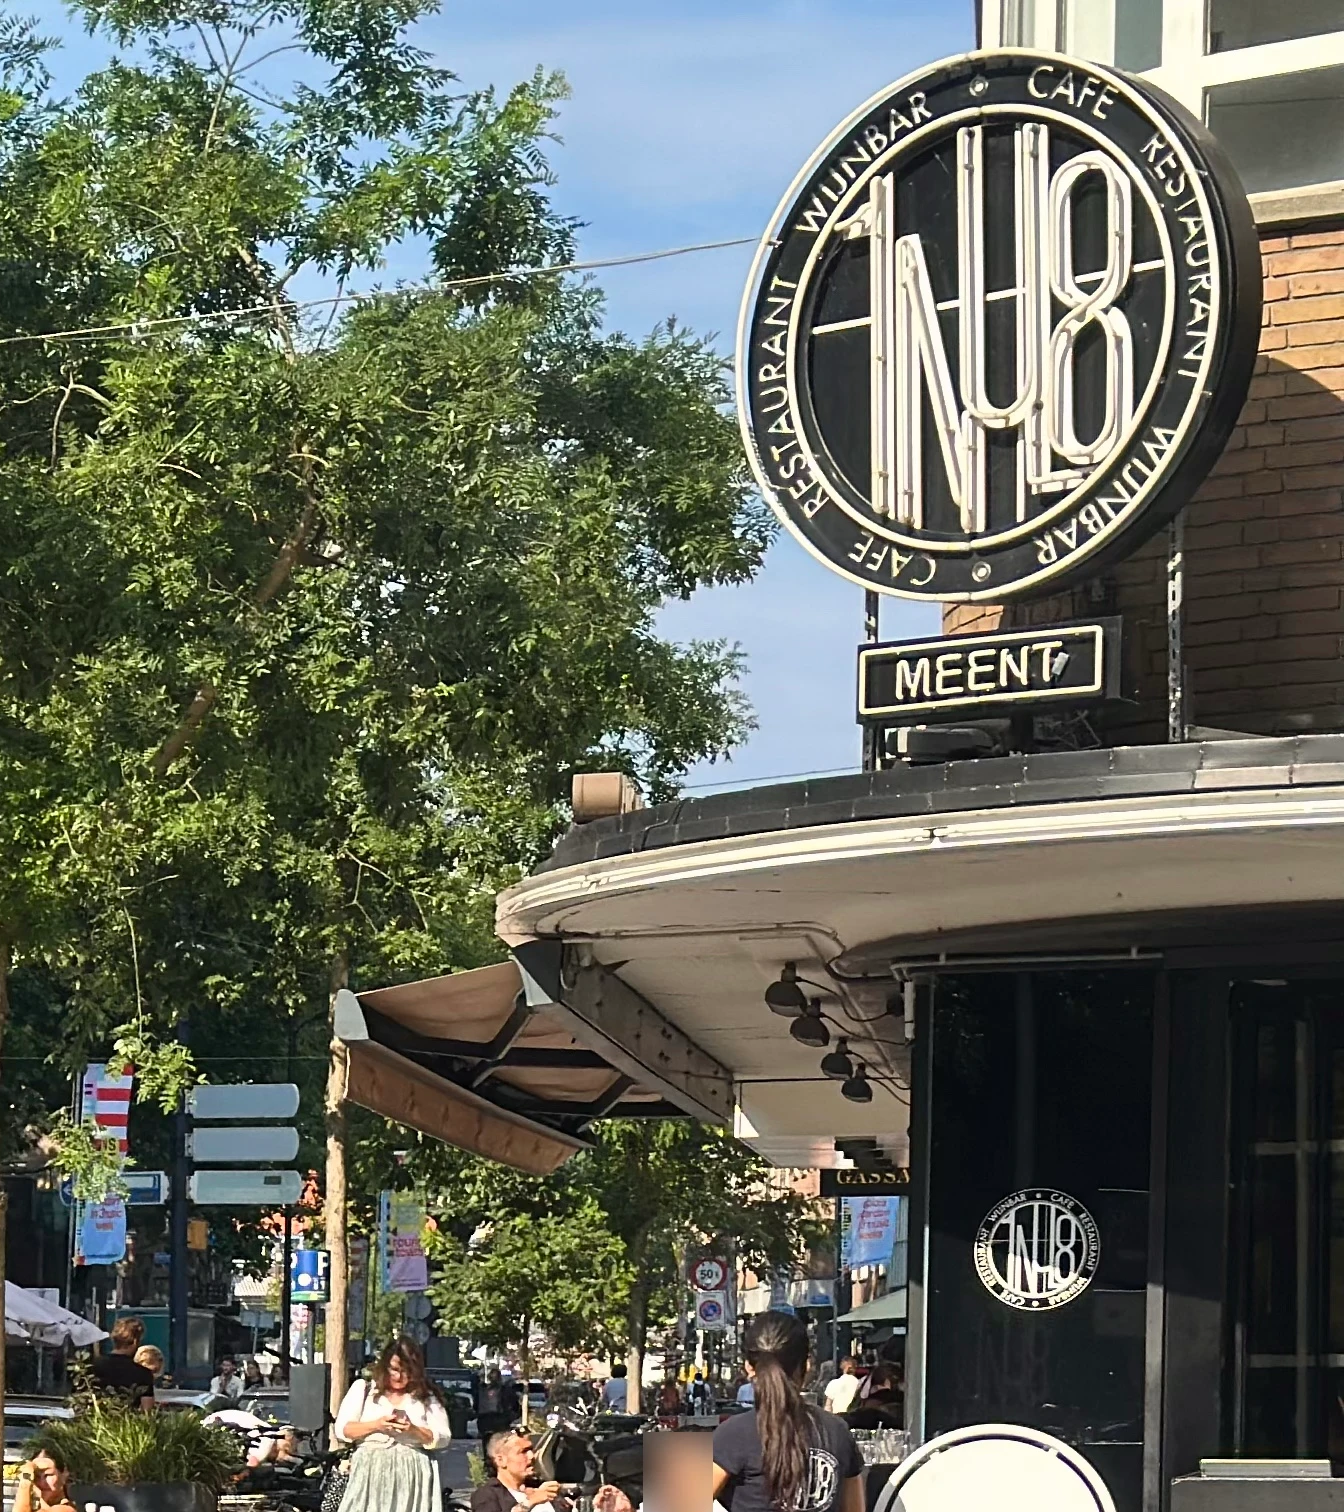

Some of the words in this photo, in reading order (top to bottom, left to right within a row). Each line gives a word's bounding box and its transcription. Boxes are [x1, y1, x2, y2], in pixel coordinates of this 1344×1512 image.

[1027, 64, 1118, 120] CAFE
[795, 91, 933, 234] WIJNBAR
[1140, 132, 1216, 380] RESTAURANT
[758, 278, 831, 520] RESTAURANT
[1035, 425, 1180, 567] WIJNBAR
[847, 530, 937, 587] CAFE
[894, 643, 1063, 701] MEENT
[1079, 1212, 1098, 1271] RESTAURANT
[700, 1269, 714, 1280] 50
